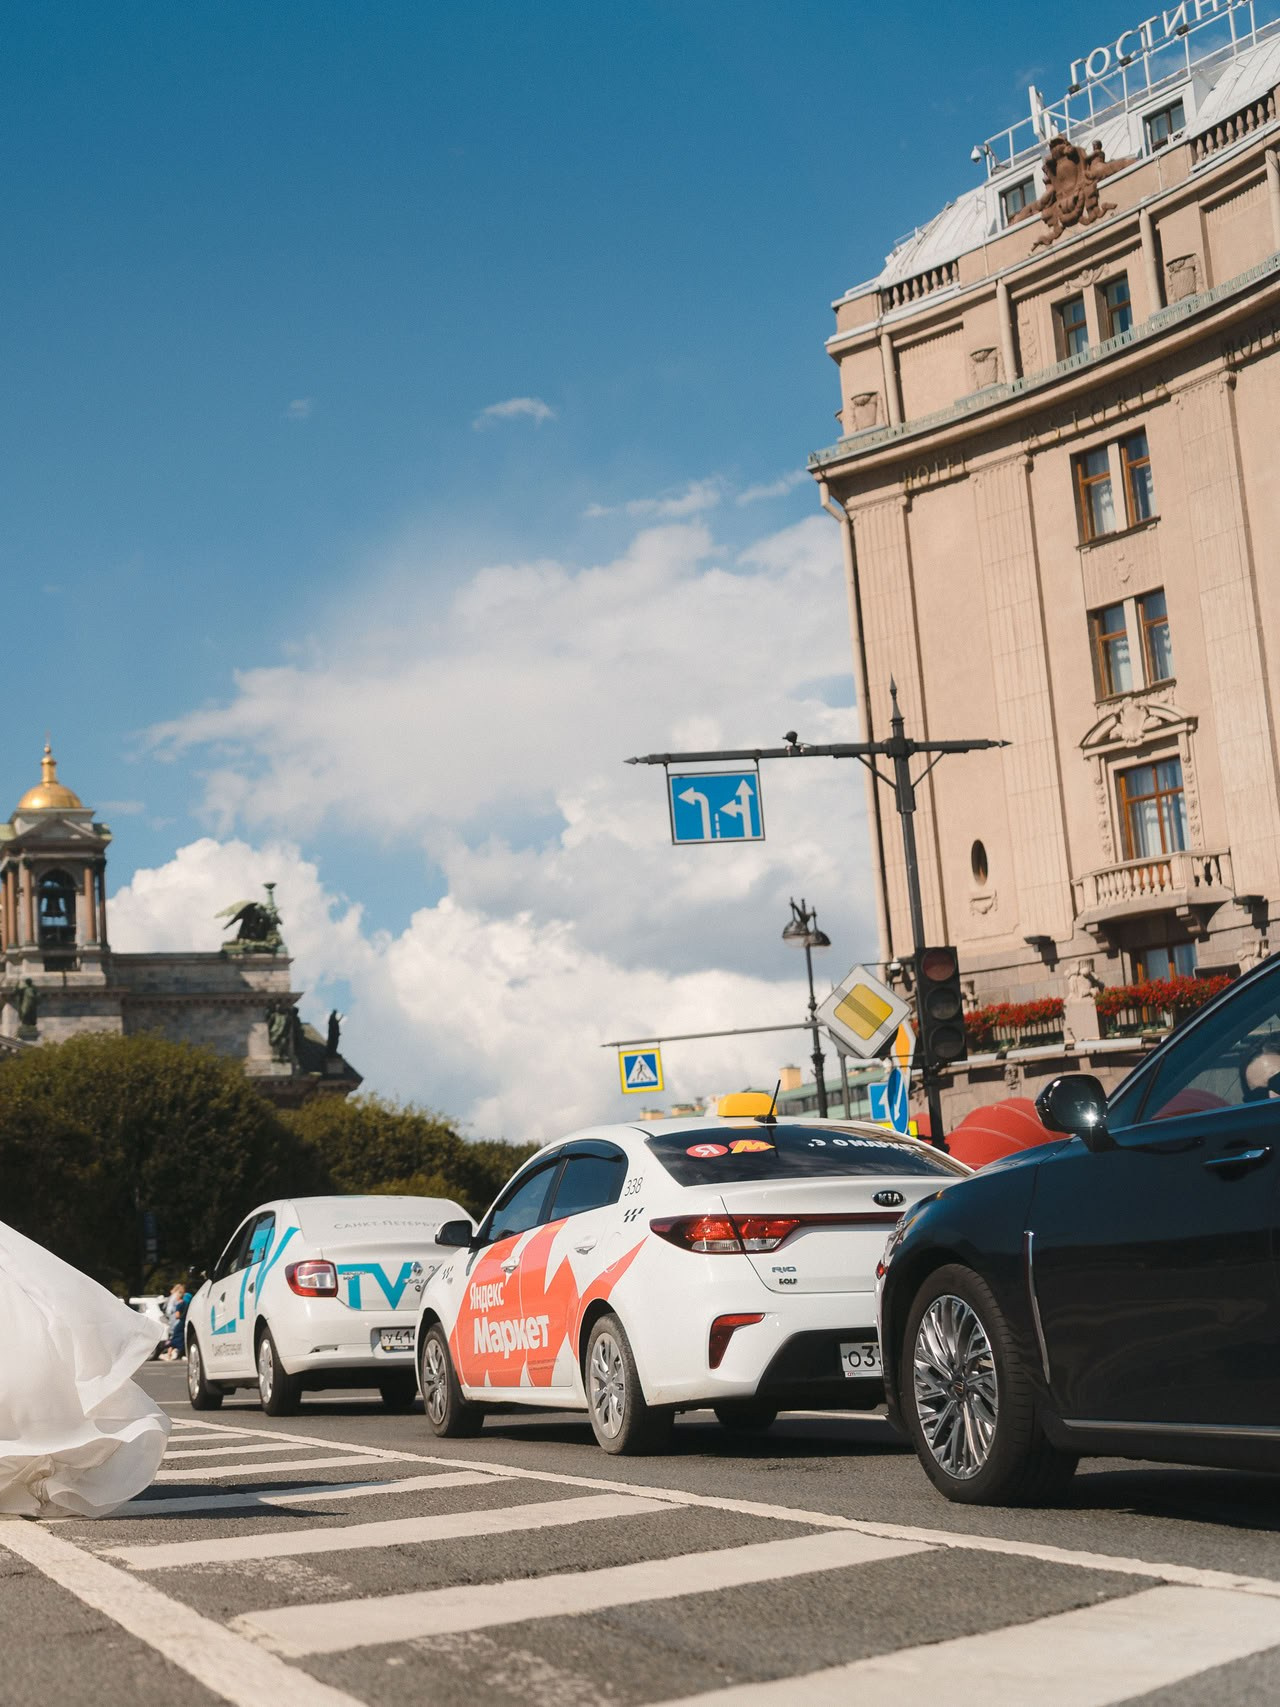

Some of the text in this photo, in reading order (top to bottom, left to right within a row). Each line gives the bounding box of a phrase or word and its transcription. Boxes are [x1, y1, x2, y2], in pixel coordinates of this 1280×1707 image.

[624, 1177, 643, 1197] 338
[877, 1192, 901, 1204] KIA
[771, 1266, 797, 1274] RIO
[470, 1282, 504, 1313] Яндекс
[474, 1315, 549, 1359] Маркет
